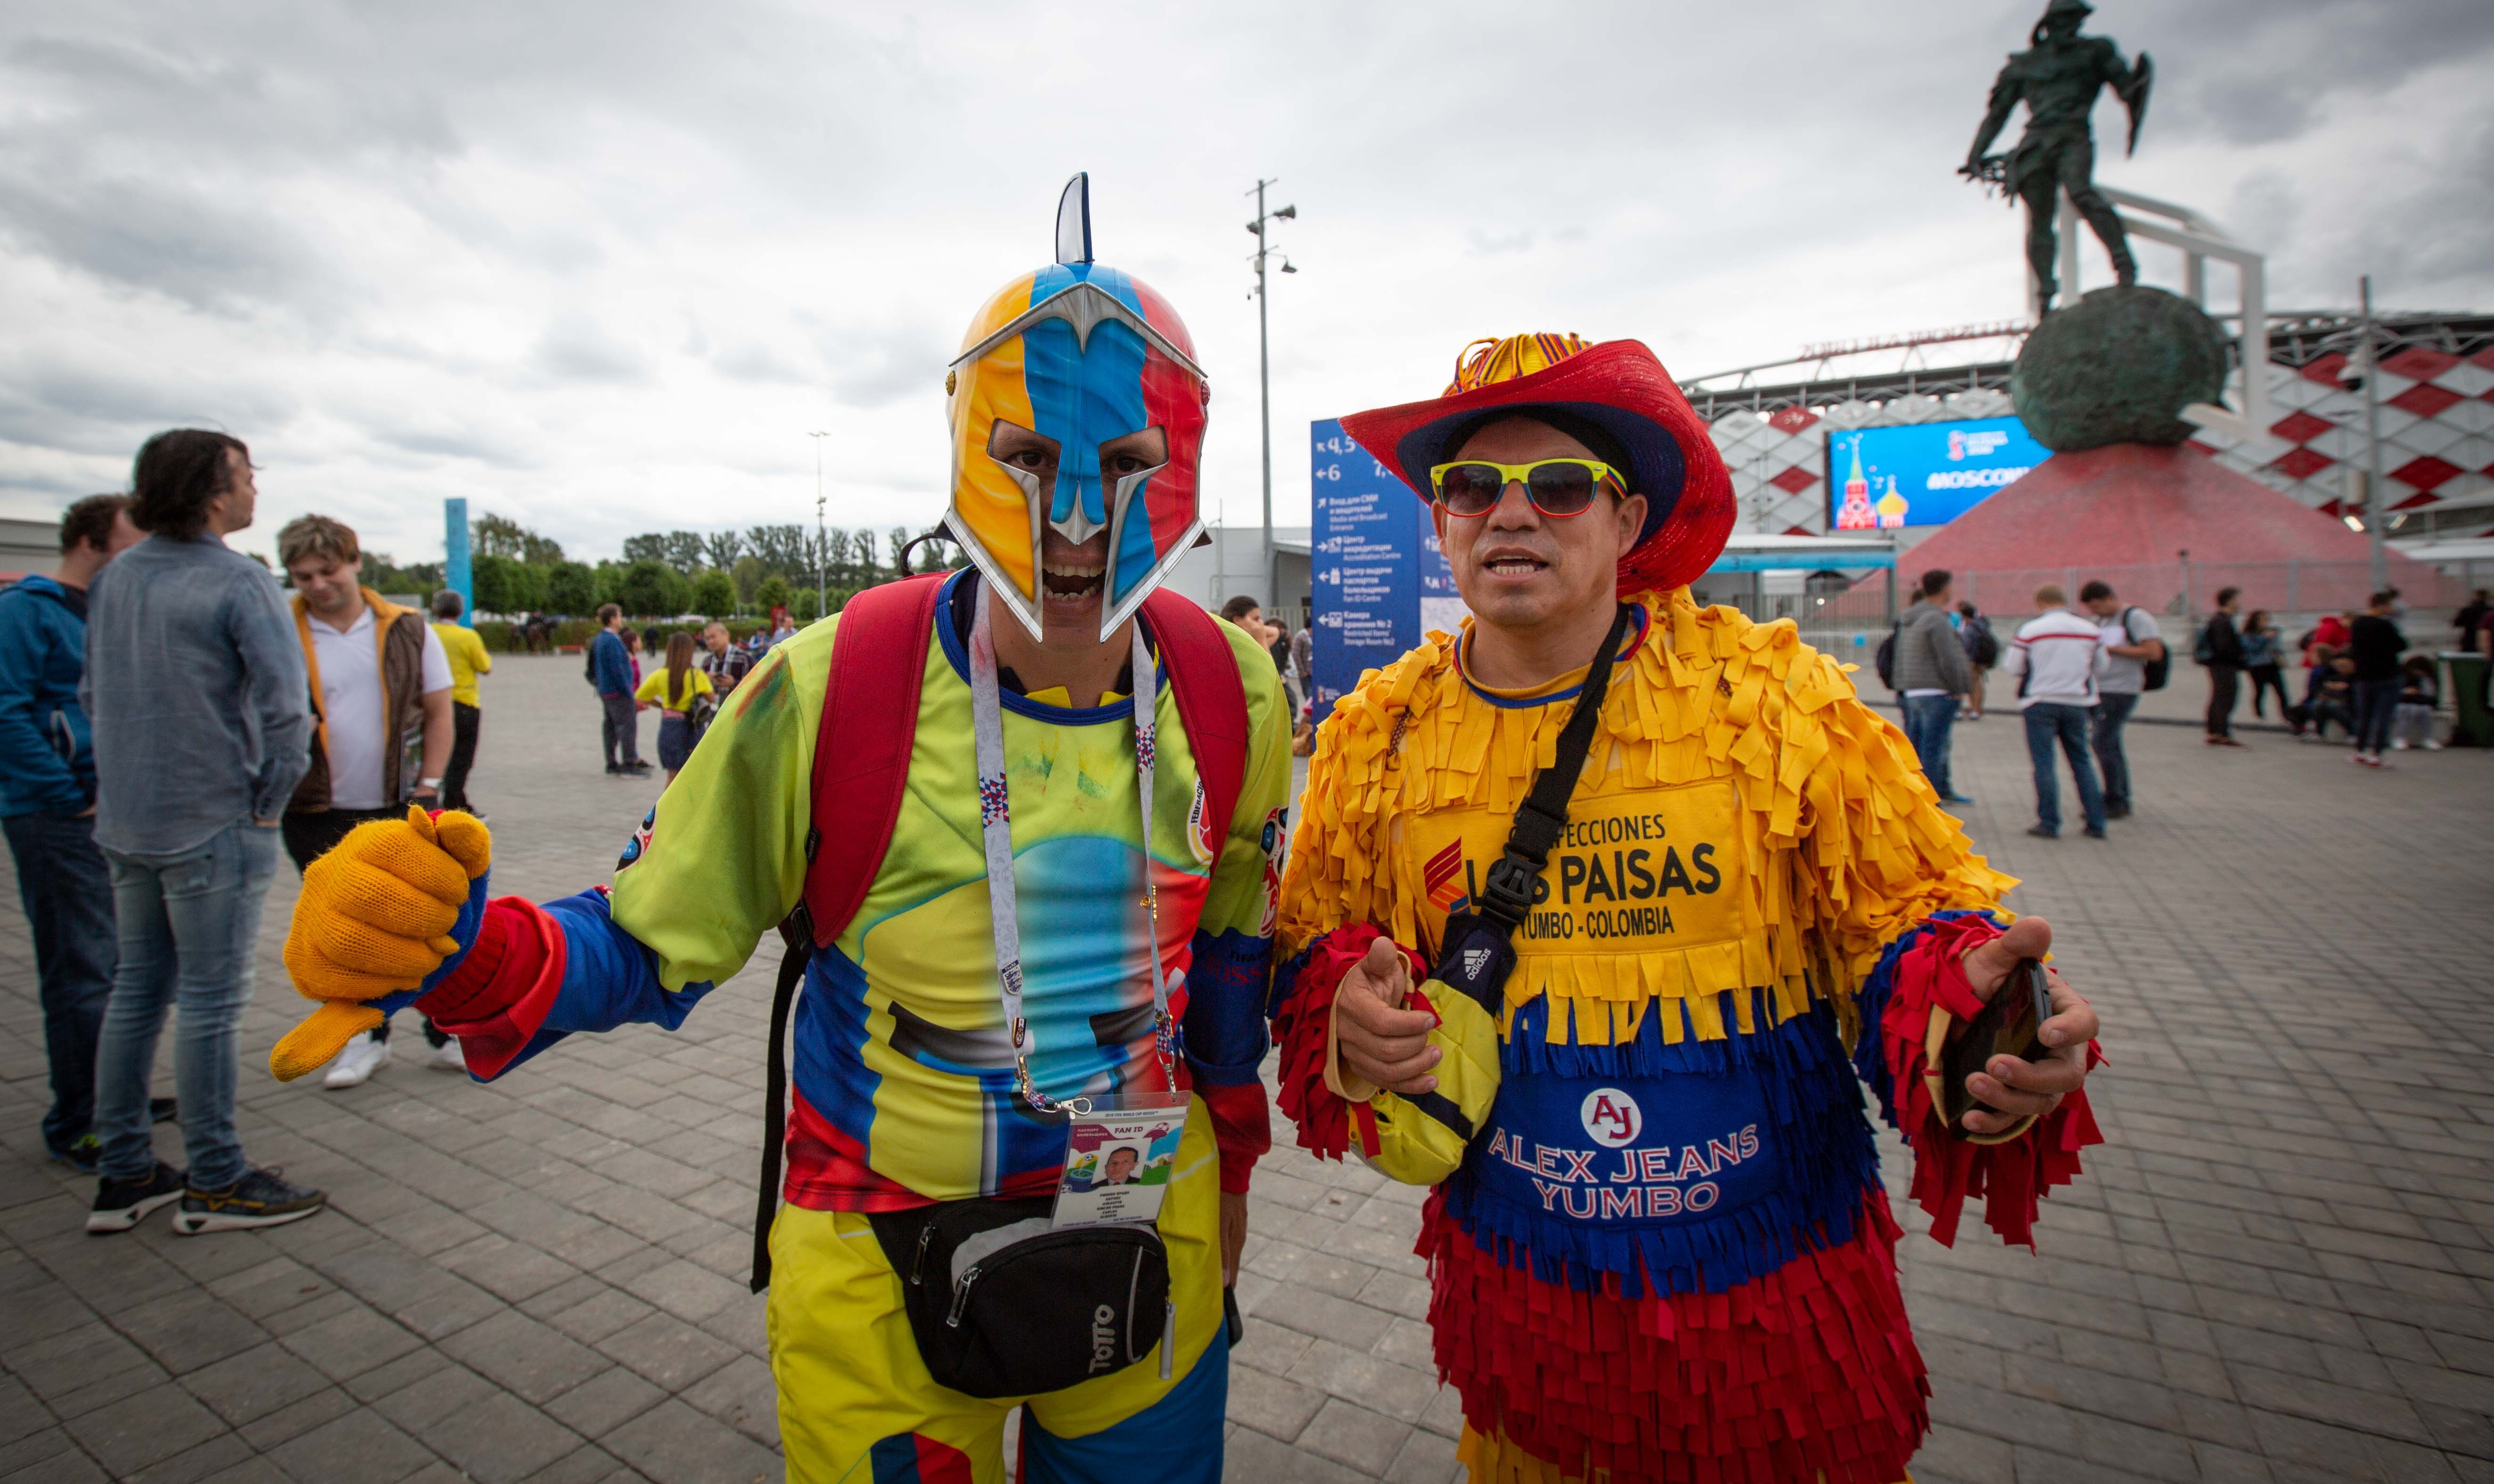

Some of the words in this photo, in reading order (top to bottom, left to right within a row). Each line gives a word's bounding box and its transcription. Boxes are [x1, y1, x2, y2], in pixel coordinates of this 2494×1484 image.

[1328, 464, 1341, 481] 6
[1561, 842, 1722, 905] PAISAS
[1586, 905, 1675, 939] COLOMBIA
[1467, 948, 1492, 980] adidas
[1488, 1127, 1599, 1183] ALEX
[1610, 1124, 1759, 1182] JEANS
[1532, 1177, 1720, 1220] YUMBO
[1088, 1305, 1115, 1373] TOTTO
